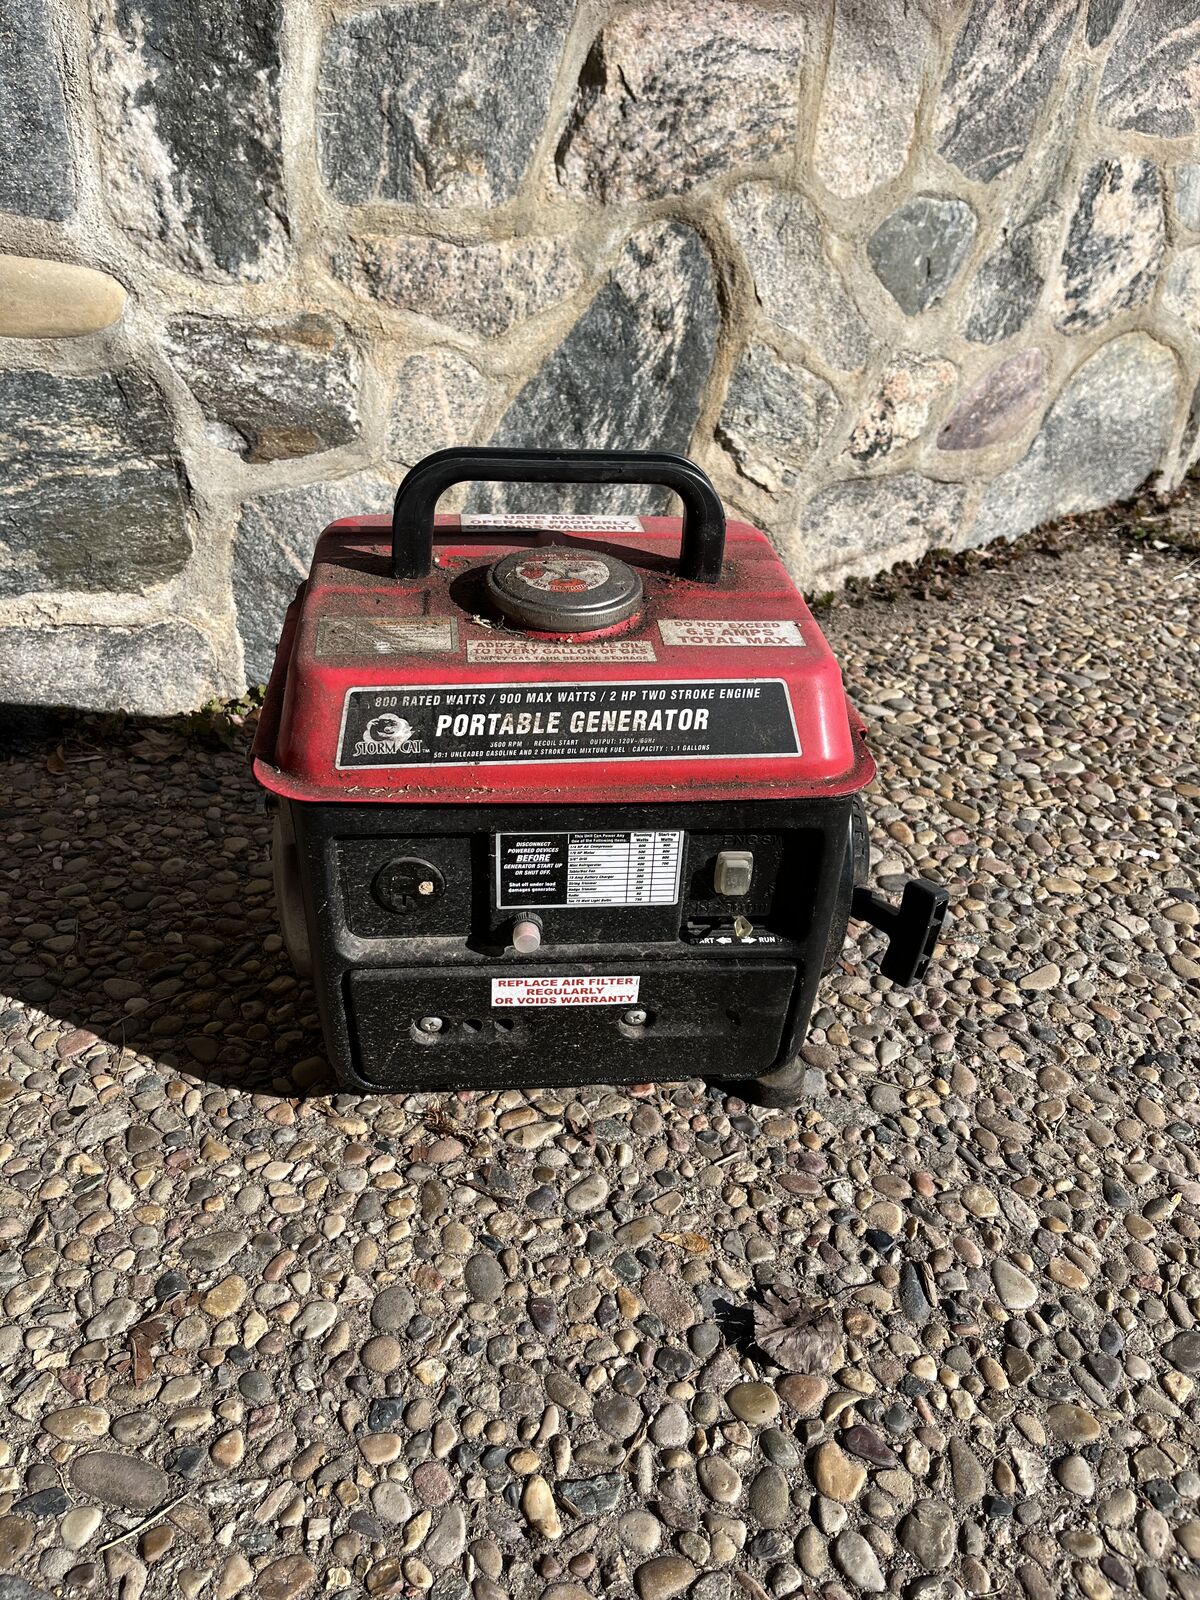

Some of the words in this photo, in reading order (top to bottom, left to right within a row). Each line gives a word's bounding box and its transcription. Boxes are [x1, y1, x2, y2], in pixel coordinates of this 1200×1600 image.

[686, 628, 715, 636] 6.5
[676, 636, 741, 644] TOTAL
[747, 637, 791, 645] MAX
[375, 696, 399, 708] 800
[402, 695, 441, 707] RATED
[445, 694, 487, 706] WATTS
[499, 692, 523, 704] 900
[526, 692, 554, 704] MAX
[556, 691, 598, 703] WATTS
[609, 691, 618, 702] 2
[620, 690, 638, 701] HP
[641, 690, 667, 701] TWO
[670, 689, 716, 701] STROKE
[719, 688, 762, 700] ENGINE
[435, 711, 563, 737] PORTABLE
[569, 708, 710, 734] GENERATOR
[353, 740, 398, 757] STORM
[507, 740, 524, 748] RPM
[450, 750, 485, 758] UNLEADED
[486, 749, 518, 757] GASOLINE
[540, 748, 566, 756] STROKE
[632, 745, 664, 753] CAPACITY
[682, 744, 711, 752] GALLONS
[516, 853, 552, 864] BEFORE
[498, 979, 559, 987] REPLACE
[562, 978, 585, 986] AIR
[588, 977, 634, 986] FILTER
[526, 987, 605, 996] REGULARLY
[495, 997, 514, 1005] OR
[517, 997, 557, 1005] VOIDS
[560, 994, 635, 1004] WARRANTY
